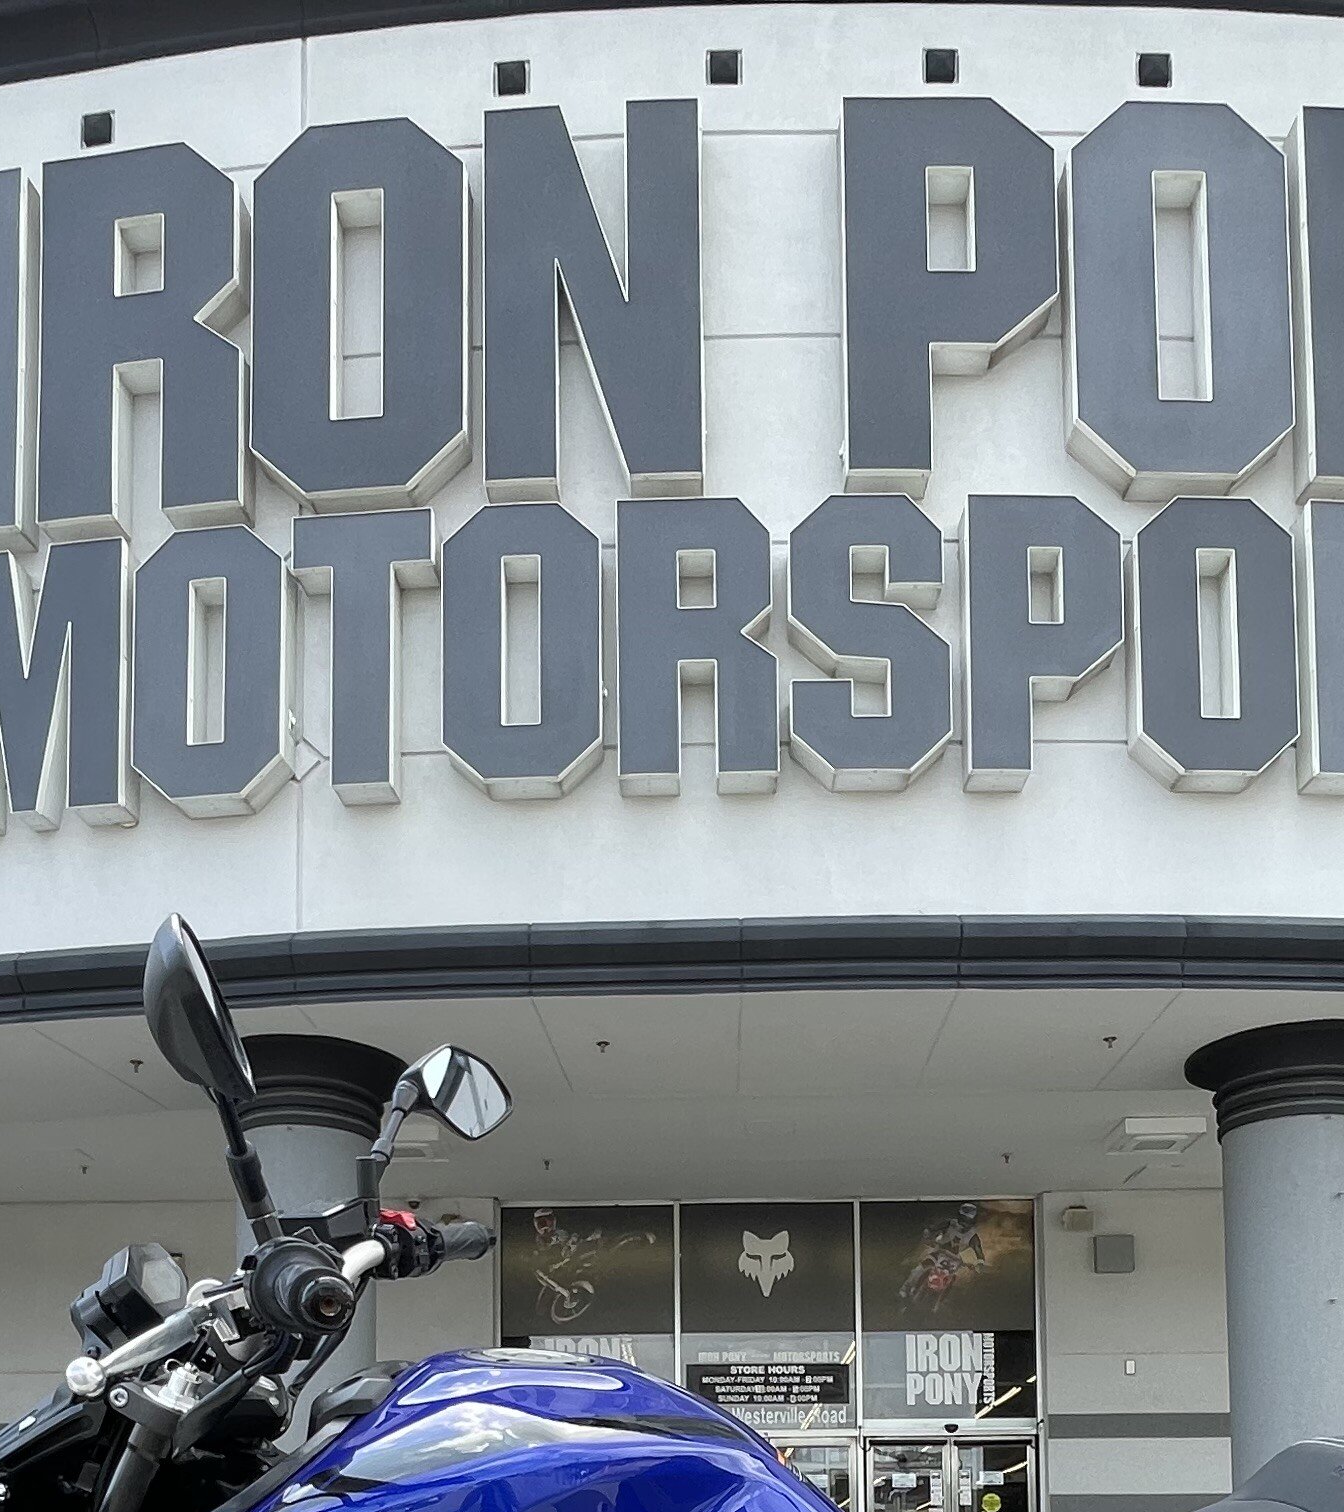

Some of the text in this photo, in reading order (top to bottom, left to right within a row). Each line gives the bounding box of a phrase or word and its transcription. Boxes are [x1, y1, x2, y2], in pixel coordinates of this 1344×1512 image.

[905, 1333, 983, 1372] IRON
[730, 1366, 805, 1374] STORE HOURS
[906, 1373, 982, 1406] PONY
